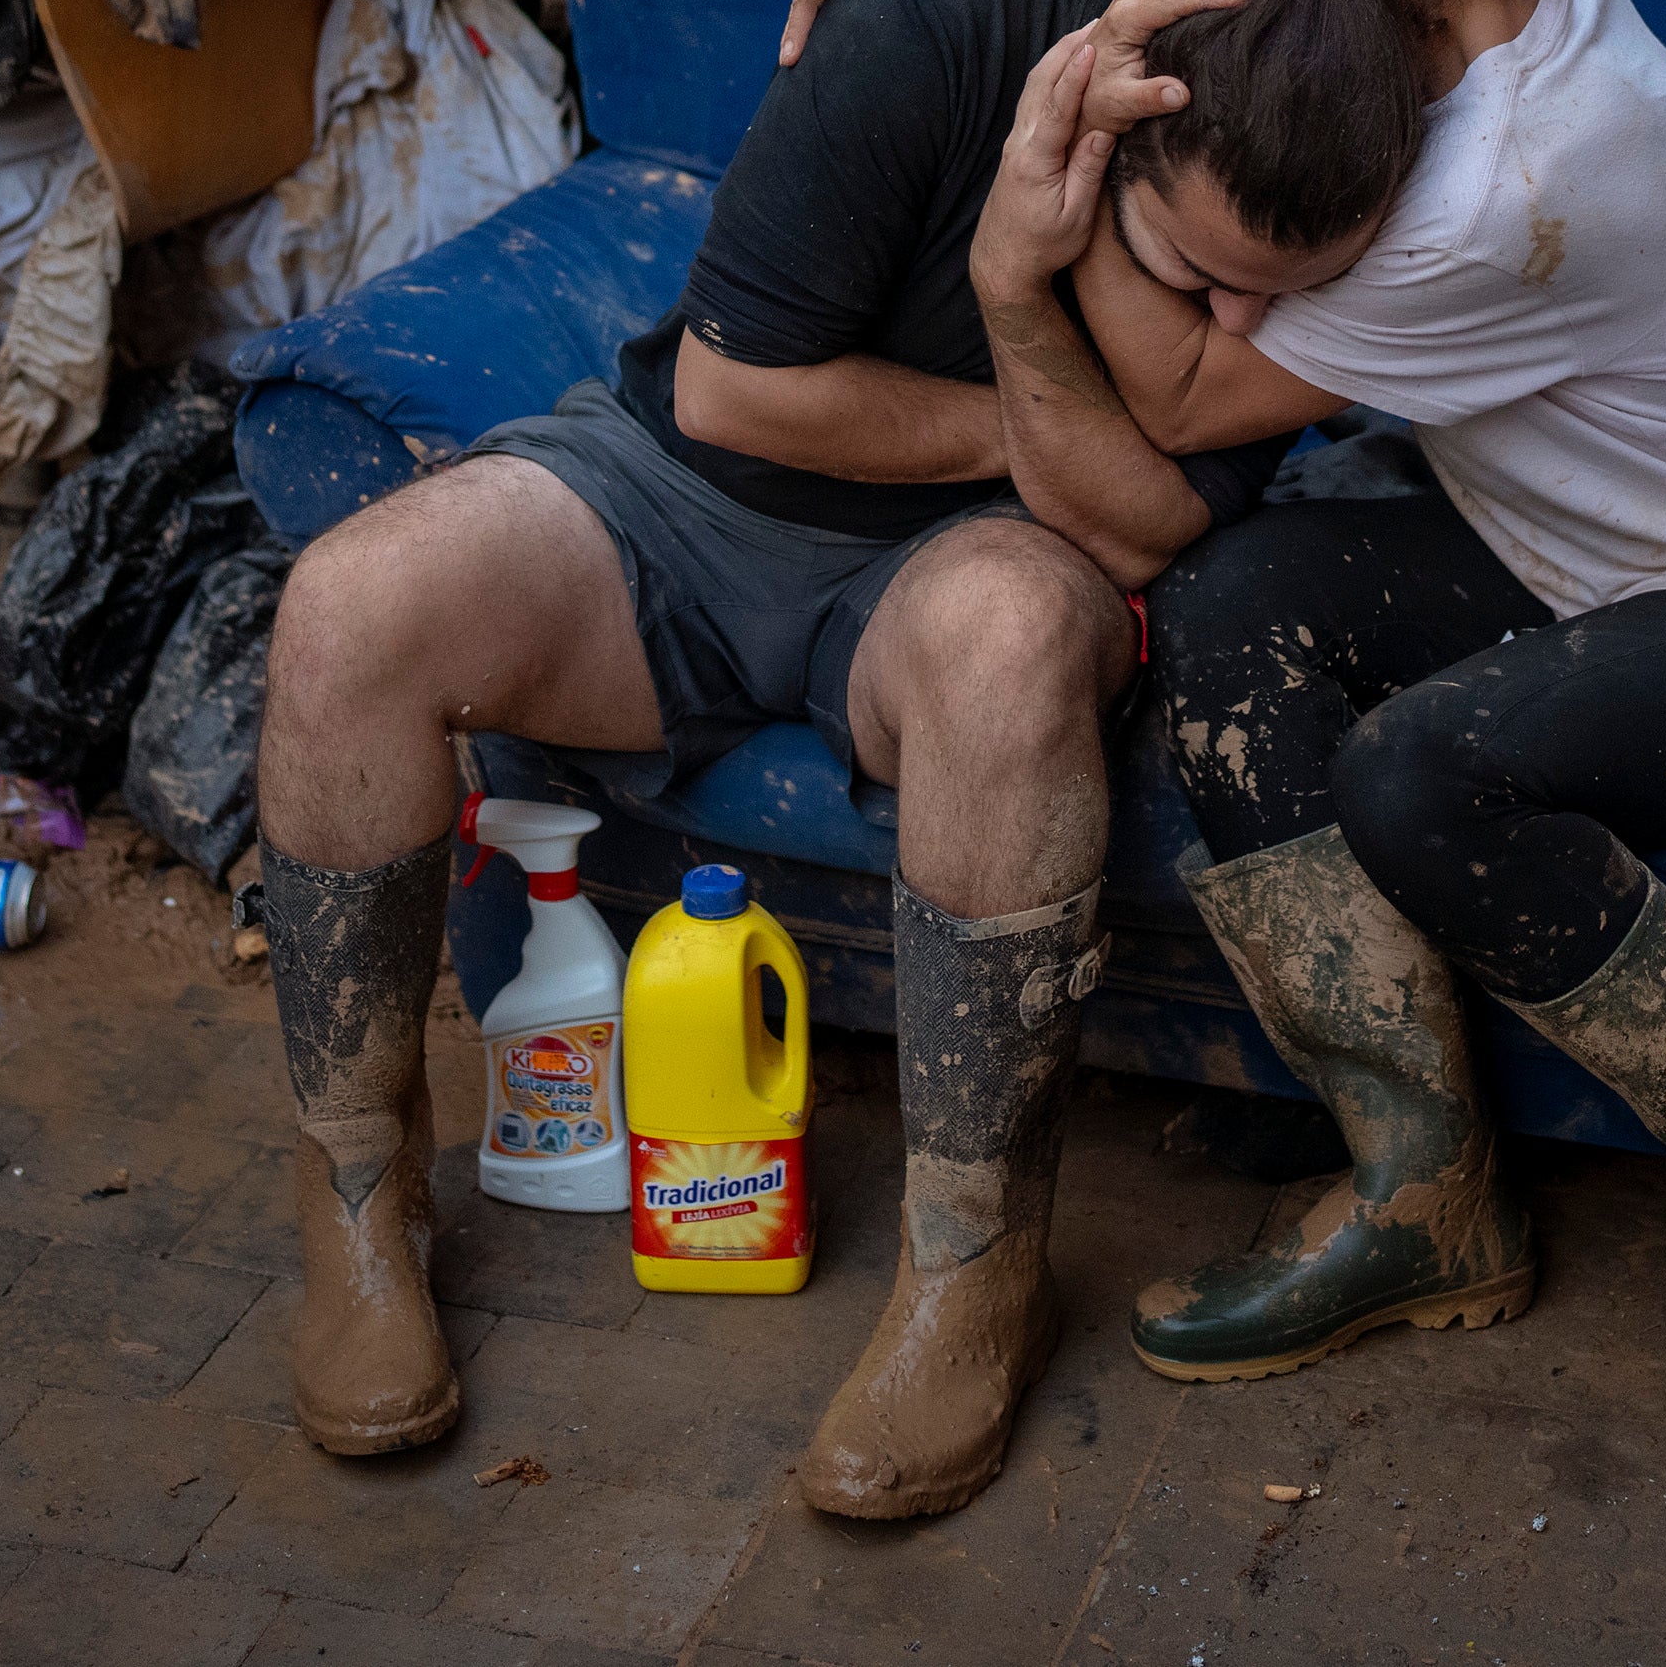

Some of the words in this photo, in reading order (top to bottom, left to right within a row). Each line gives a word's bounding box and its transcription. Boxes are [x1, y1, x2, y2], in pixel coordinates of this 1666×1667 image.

[506, 1071, 593, 1097] Quitagrasas
[550, 1096, 593, 1113] eficaz
[646, 1165, 782, 1206] Tradicional
